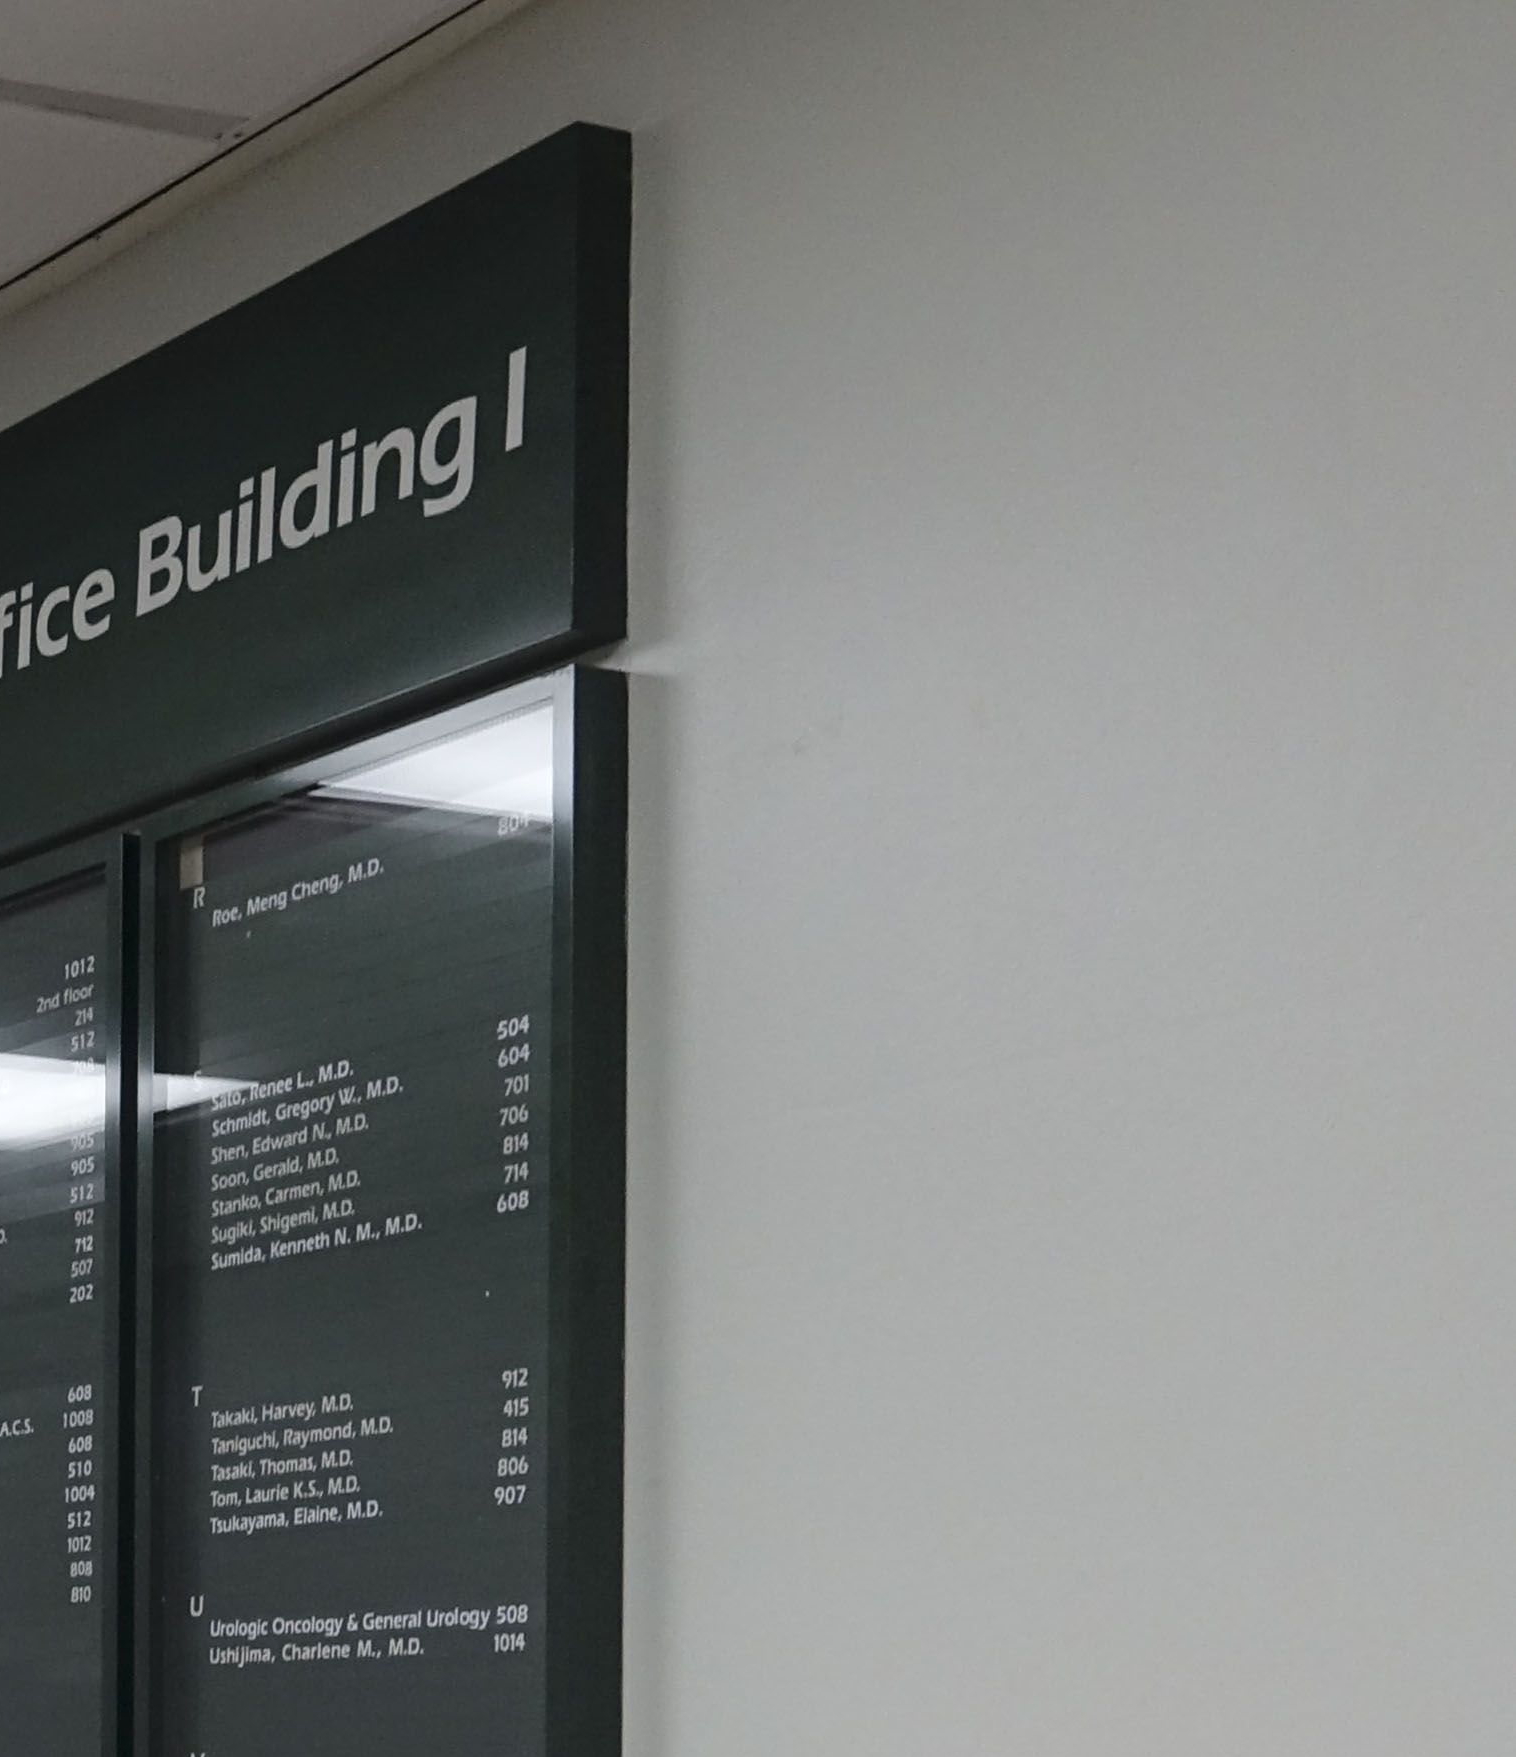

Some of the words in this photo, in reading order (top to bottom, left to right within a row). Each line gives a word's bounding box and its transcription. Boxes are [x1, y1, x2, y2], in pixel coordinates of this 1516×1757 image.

[136, 396, 476, 616] Building
[505, 347, 526, 451] I
[193, 887, 205, 909] R
[212, 906, 241, 927] Roe,
[246, 891, 287, 916] Meng
[291, 874, 343, 900] Cheng,
[347, 858, 383, 883] M.D.
[212, 1108, 270, 1137] Schmidt,
[275, 1093, 334, 1120] Gregory
[338, 1086, 361, 1105] W.,
[366, 1076, 403, 1099] M.D.
[497, 1043, 530, 1067] 604
[211, 1245, 265, 1270] Sumida,
[270, 1232, 329, 1258] Kenneth
[334, 1227, 350, 1246] N.
[356, 1222, 380, 1241] M.,
[385, 1213, 422, 1236] M.D.
[497, 1190, 528, 1213] 608
[67, 1384, 91, 1403] 608
[191, 1386, 202, 1406] T
[211, 1430, 279, 1456] Taniguchi,
[283, 1420, 356, 1448] Raymond,
[360, 1416, 393, 1436] M.D.
[503, 1396, 528, 1416] 415
[190, 1596, 204, 1617] U
[210, 1619, 268, 1640] Urologic
[272, 1616, 343, 1636] Oncology
[347, 1613, 358, 1631] &
[362, 1610, 421, 1630] General
[426, 1607, 490, 1630] Urology
[496, 1604, 528, 1624] 508
[210, 1646, 275, 1667] Ushijima,
[282, 1642, 350, 1661] Charlene
[357, 1639, 381, 1658] M.,
[388, 1637, 423, 1656] M.D.
[494, 1633, 525, 1652] 1014
